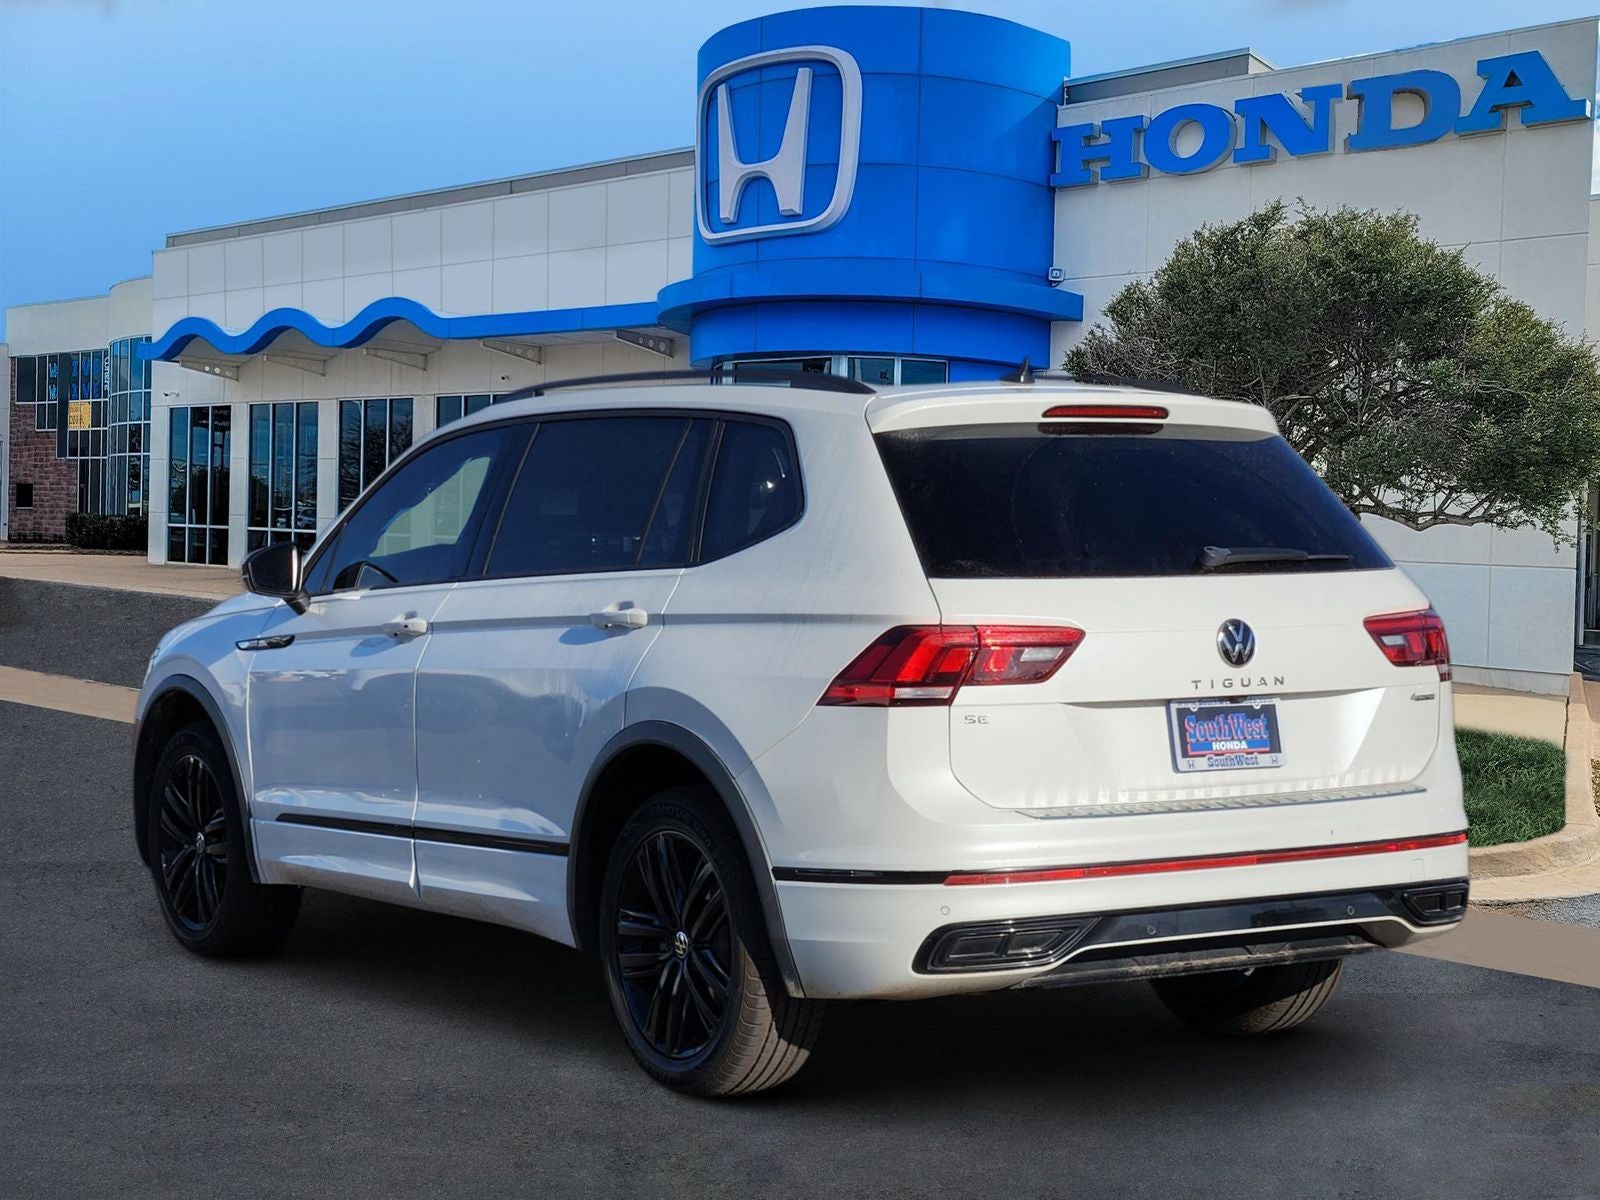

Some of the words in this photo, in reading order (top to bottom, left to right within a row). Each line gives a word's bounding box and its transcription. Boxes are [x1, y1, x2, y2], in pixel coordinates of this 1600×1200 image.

[1050, 50, 1592, 187] HONDA
[1191, 676, 1285, 690] TIGUAN
[964, 714, 991, 725] SE
[1184, 712, 1269, 742] SouthWest
[1212, 740, 1249, 751] HONDA
[1207, 754, 1260, 768] SouthWest
